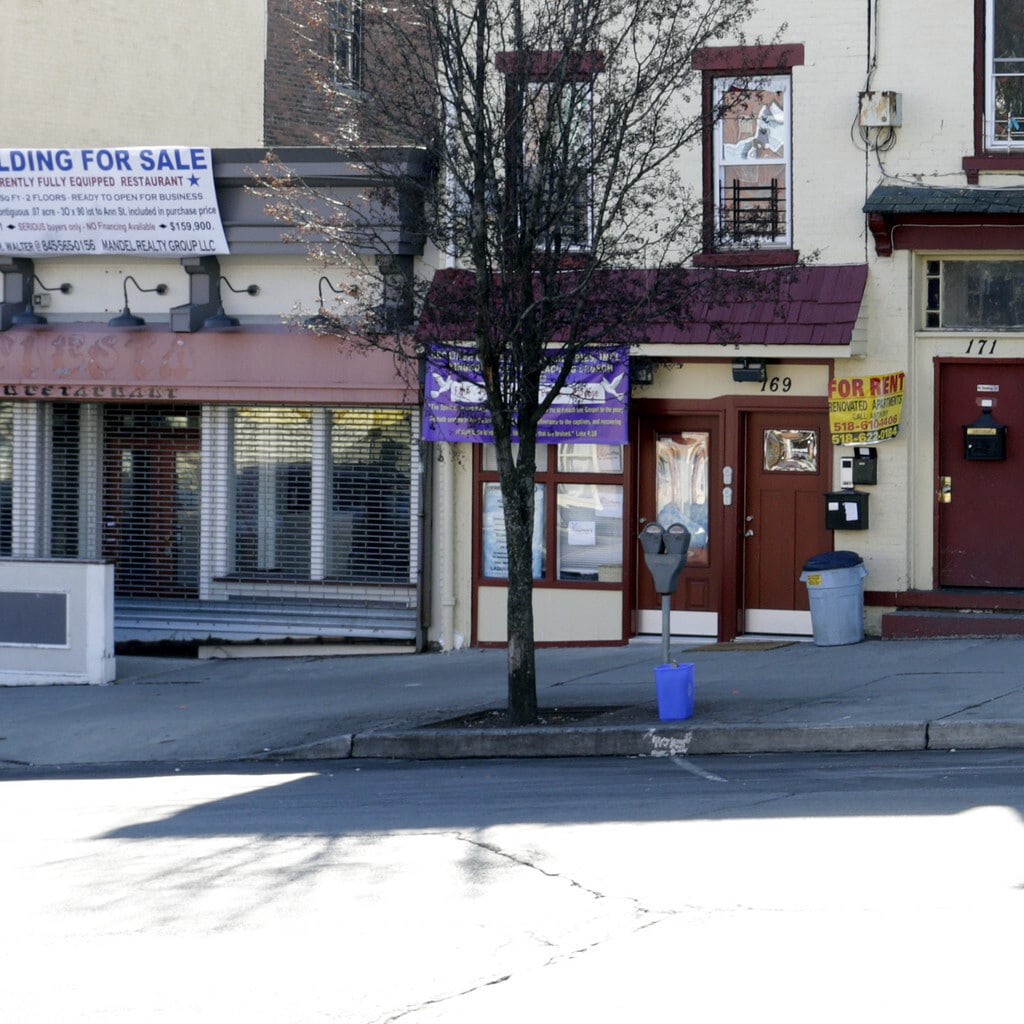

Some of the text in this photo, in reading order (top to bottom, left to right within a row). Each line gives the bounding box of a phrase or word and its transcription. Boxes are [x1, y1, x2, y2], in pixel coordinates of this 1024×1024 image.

[81, 149, 133, 171] FOR
[140, 148, 208, 171] SALE
[37, 176, 67, 187] FULLY
[69, 176, 115, 187] EQUIPPED
[121, 175, 183, 187] RESTAURANT
[33, 194, 67, 202] FLOORS
[71, 193, 99, 202] READY
[101, 193, 112, 201] TO
[114, 193, 138, 201] OPEN
[139, 193, 157, 201] FOR
[159, 192, 204, 201] BUSINESS
[128, 206, 157, 216] included
[157, 206, 165, 215] in
[166, 207, 198, 217] purchase
[199, 206, 217, 217] price
[18, 222, 46, 231] SERIOUS
[169, 221, 215, 231] $159,900.
[101, 239, 136, 252] MANDEL
[136, 239, 167, 252] REALTY
[168, 239, 198, 252] GROUP
[199, 239, 216, 252] LLC
[965, 338, 997, 355] 171
[828, 372, 905, 399] FOR RENT
[829, 400, 868, 412] RENOVATED
